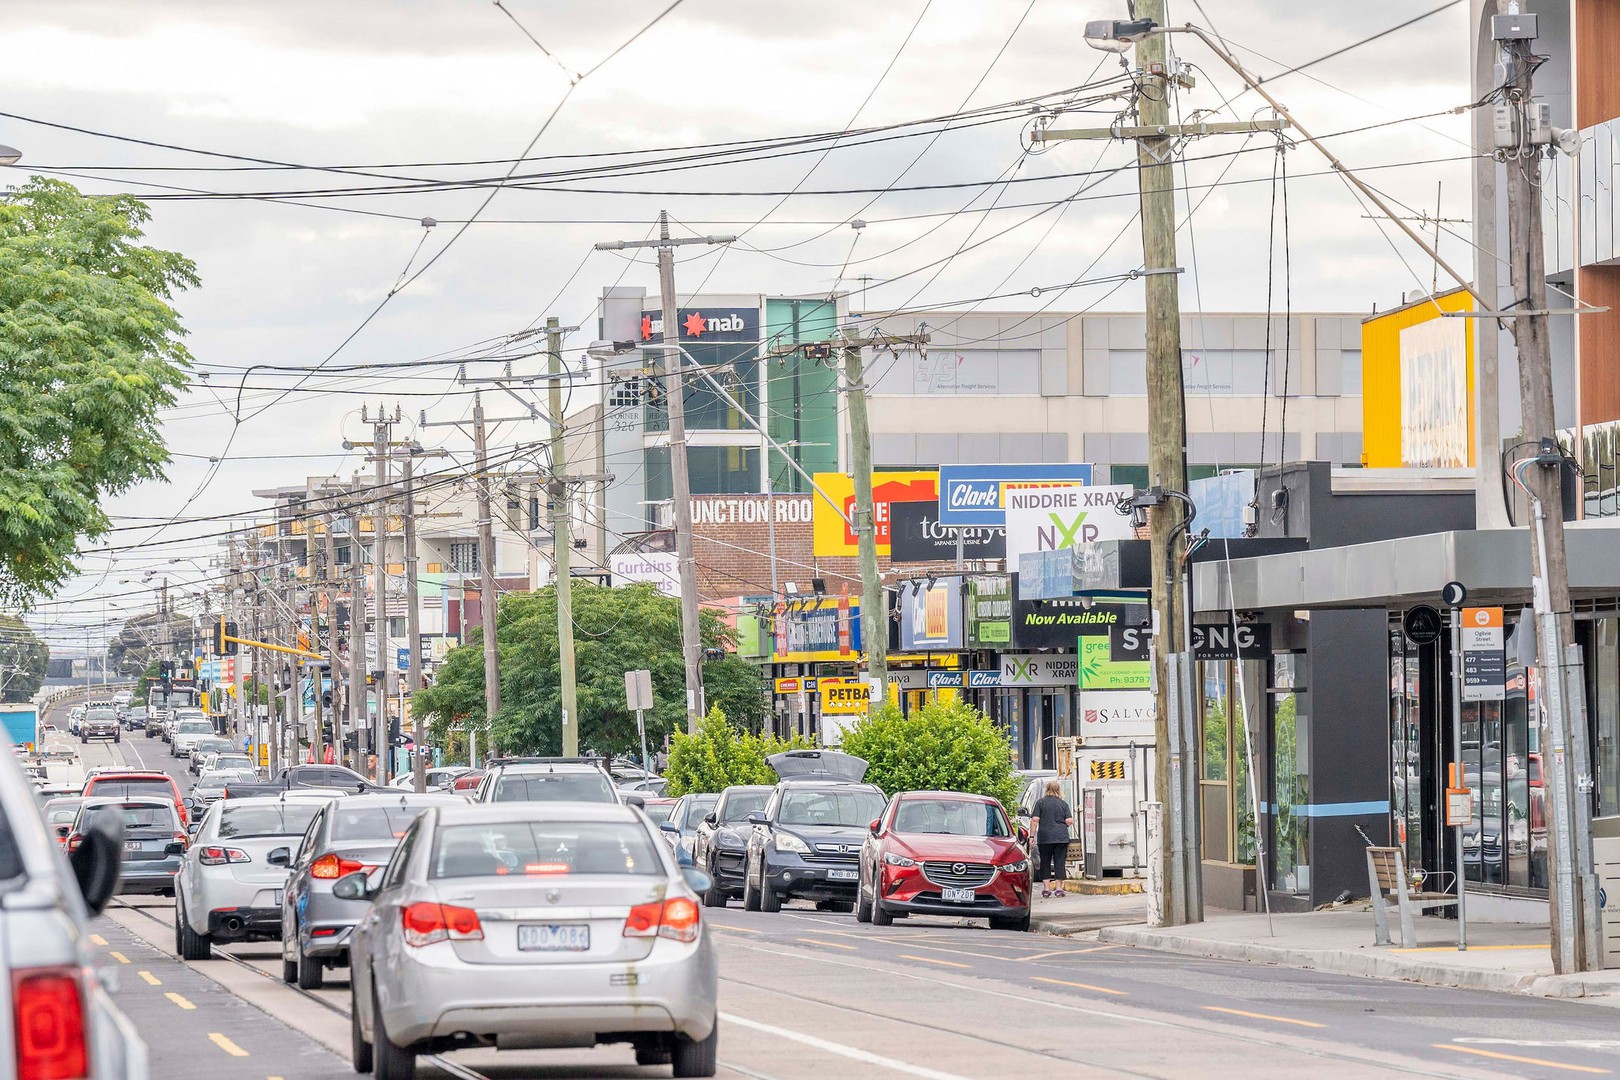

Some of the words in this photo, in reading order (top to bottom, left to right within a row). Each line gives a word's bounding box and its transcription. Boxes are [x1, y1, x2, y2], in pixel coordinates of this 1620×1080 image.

[708, 314, 745, 332] nab
[614, 421, 636, 432] 326
[950, 483, 998, 507] Clark
[1011, 493, 1078, 509] NIDDRIE
[1083, 491, 1126, 507] XRAY
[690, 500, 768, 523] UNCTION
[776, 499, 812, 522] ROO
[1037, 511, 1100, 551] NXR
[617, 560, 673, 575] Curtains
[1025, 613, 1056, 625] Now
[1056, 611, 1118, 624] Available
[1006, 656, 1039, 682] NXR
[1045, 661, 1078, 670] NIDDRI
[1052, 669, 1077, 678] XRAY
[888, 671, 910, 684] aiya
[929, 672, 962, 686] Clark
[1110, 676, 1123, 684] Ph:
[1124, 676, 1145, 684] 9379
[829, 687, 870, 701] PETBA
